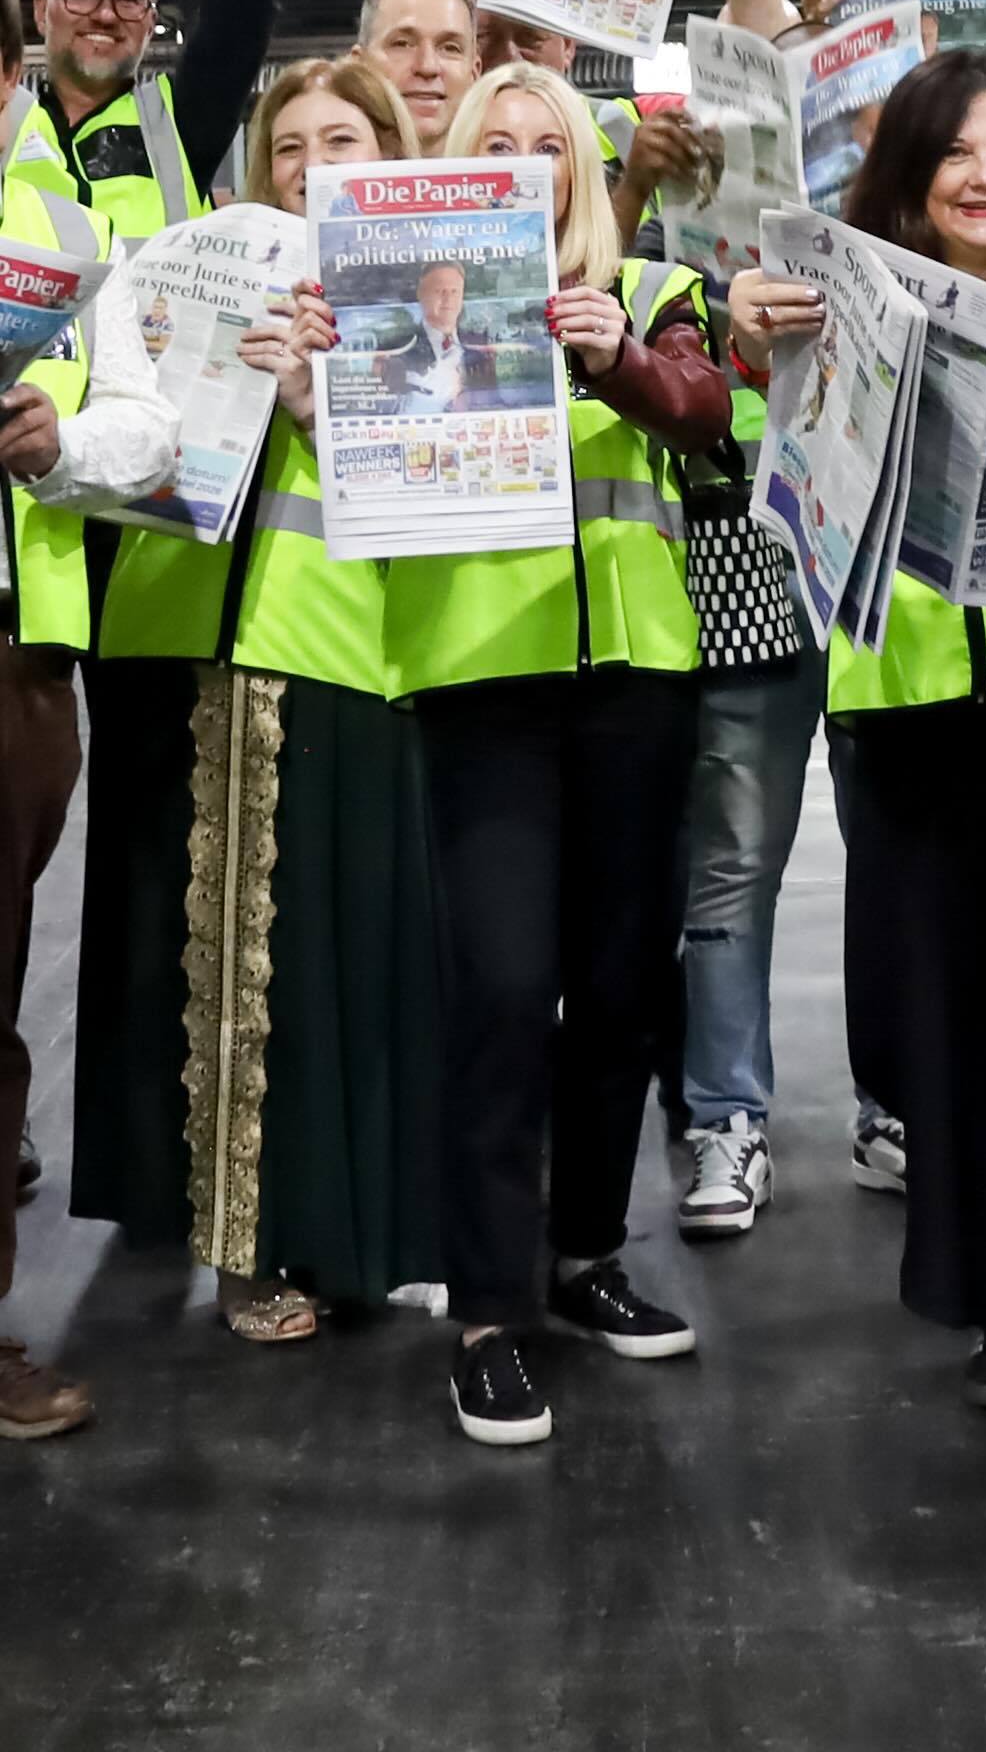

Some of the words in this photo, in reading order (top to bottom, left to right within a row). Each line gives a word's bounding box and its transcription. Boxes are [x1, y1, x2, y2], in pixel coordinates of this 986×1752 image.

[922, 0, 955, 15] eng
[733, 44, 777, 79] Sport
[817, 49, 840, 74] Die
[840, 28, 884, 65] Papier
[363, 180, 410, 204] Die
[413, 176, 496, 208] Papier
[186, 229, 251, 260] Sport
[356, 222, 399, 242] DG:
[481, 221, 508, 235] en
[335, 244, 416, 272] politici
[423, 247, 487, 266] meng
[161, 259, 191, 276] oor
[194, 263, 239, 288] Jurie
[242, 276, 263, 293] se
[784, 259, 830, 283] Vrae
[833, 278, 852, 302] oor
[844, 247, 878, 311] Sport
[889, 269, 928, 299] ort
[150, 279, 241, 310] speelkans
[368, 428, 394, 440] Pay
[336, 446, 400, 463] NAWEEK-
[336, 456, 401, 474] WENNERS
